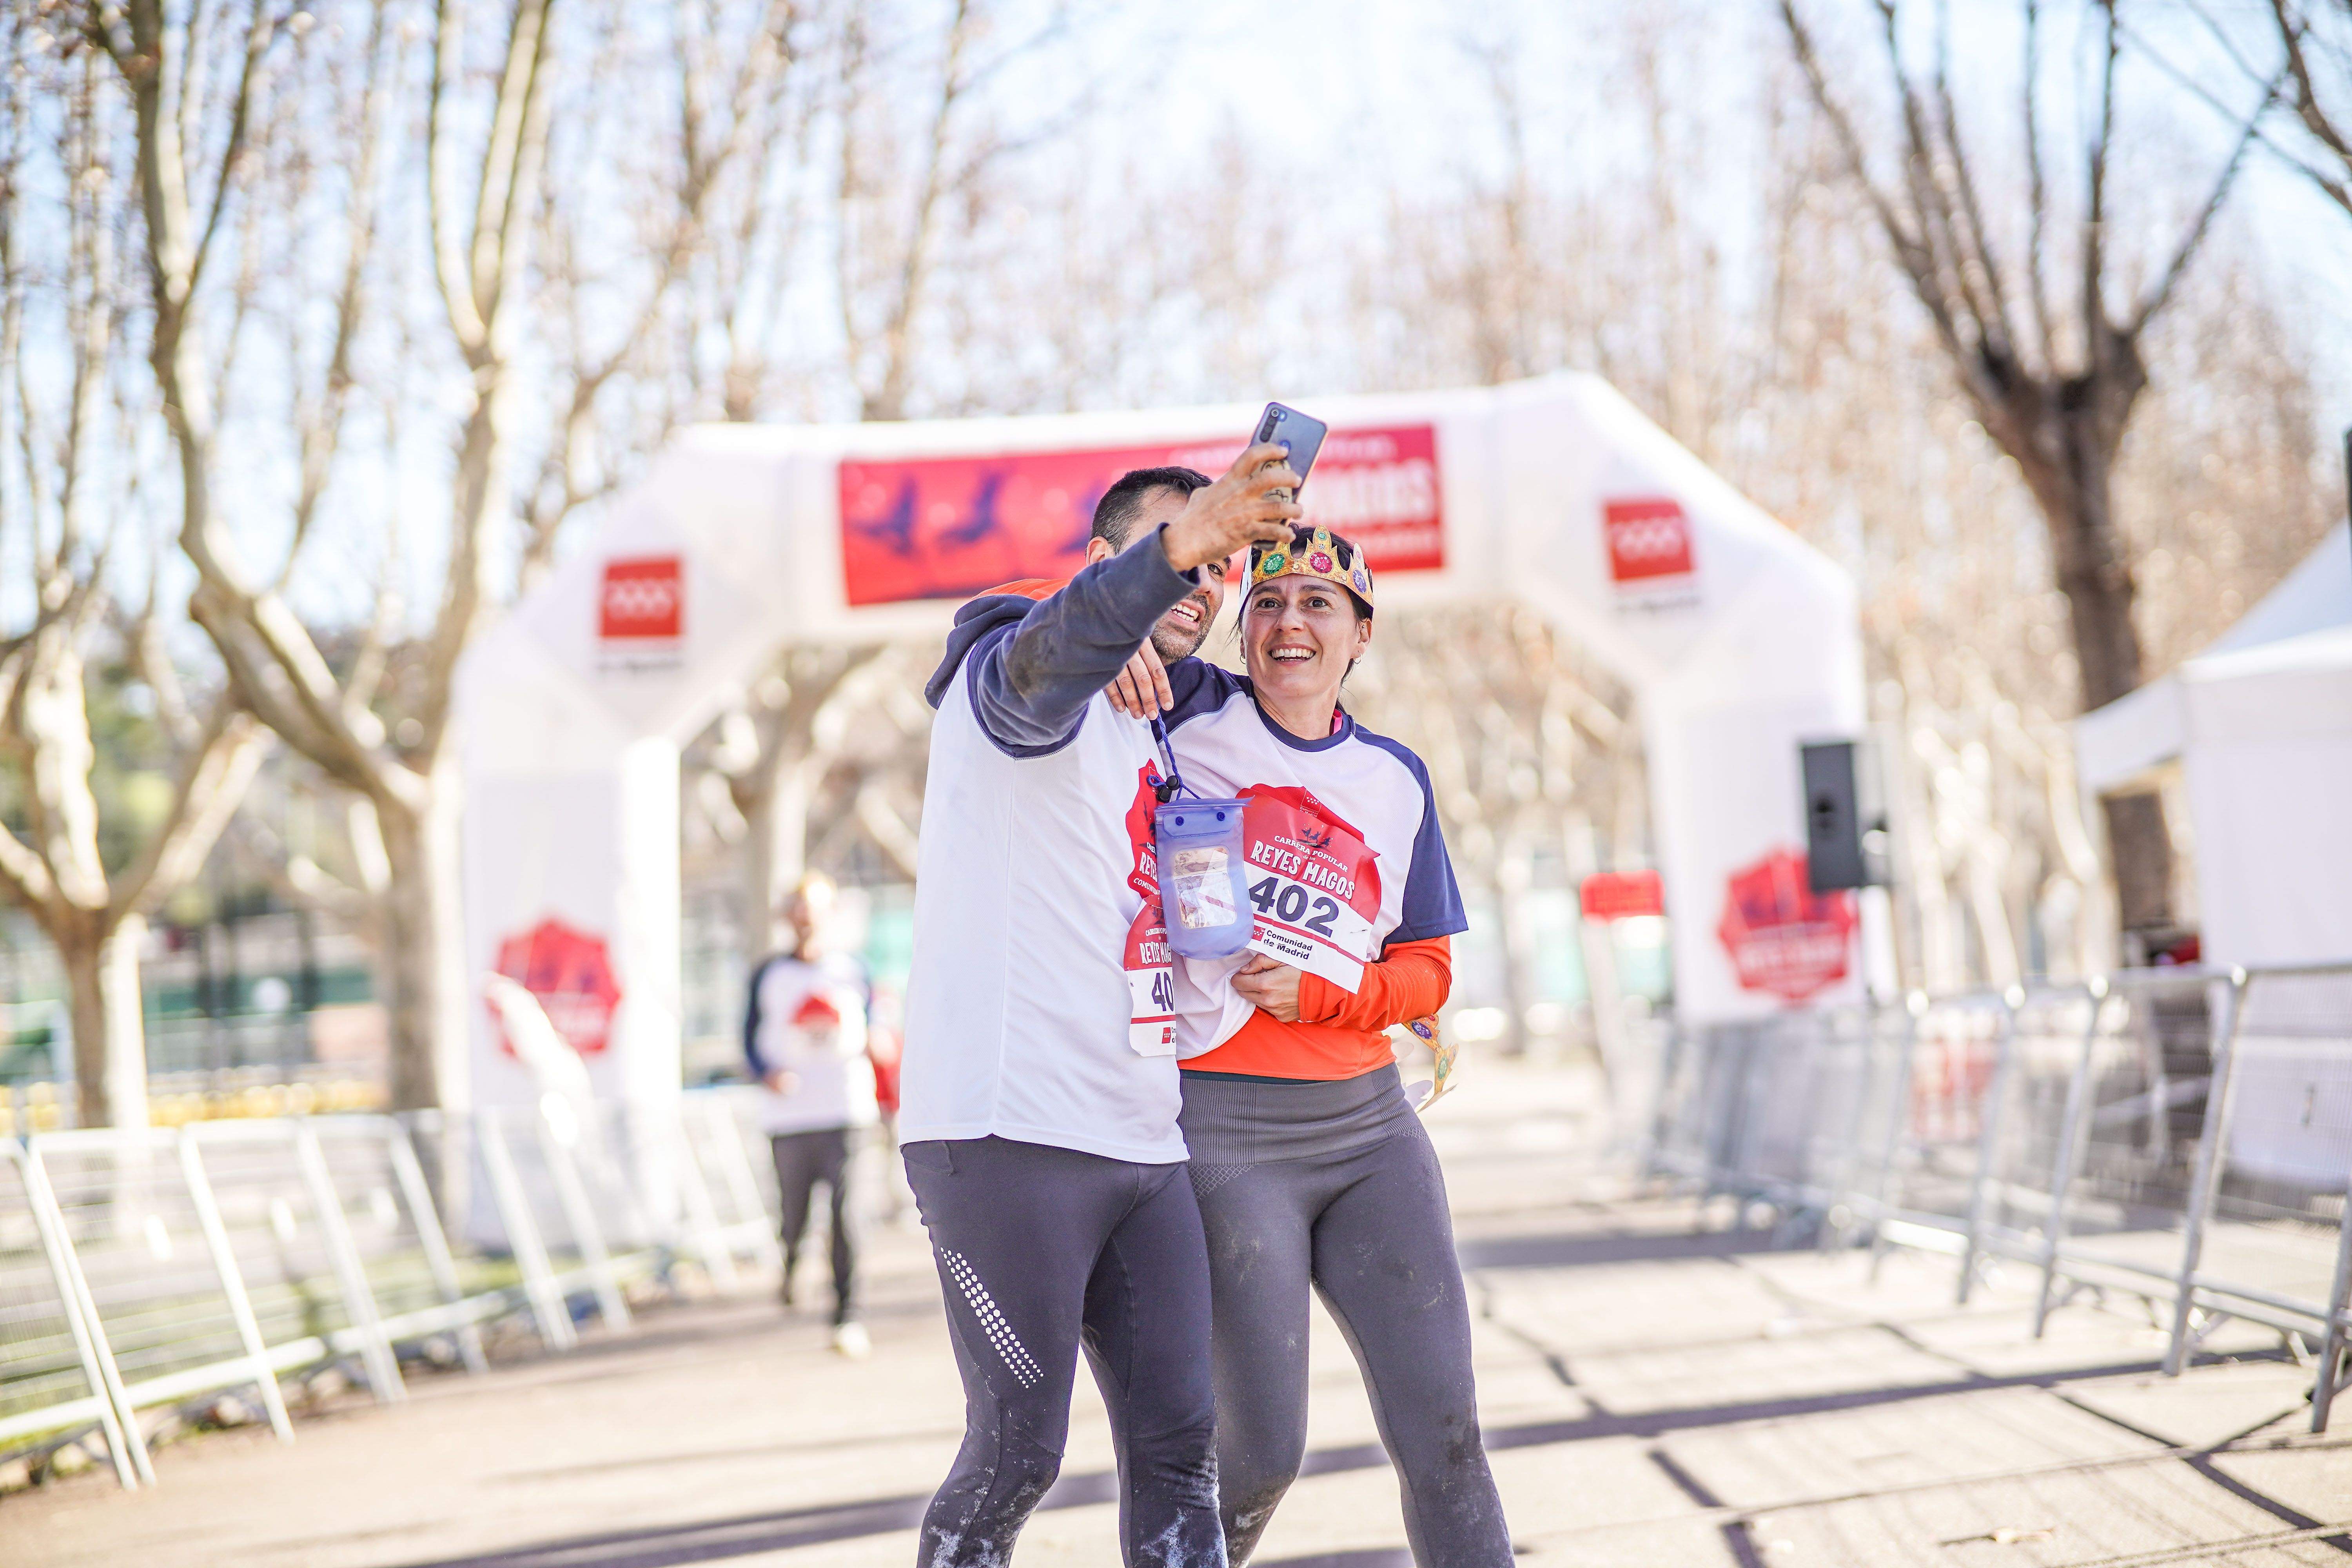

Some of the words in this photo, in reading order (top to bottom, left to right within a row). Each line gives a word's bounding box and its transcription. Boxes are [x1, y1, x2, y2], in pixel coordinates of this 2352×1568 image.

[1250, 840, 1301, 875] REYES
[1302, 862, 1355, 900] MAGOS
[1274, 835, 1310, 855] CARRERA
[1312, 850, 1348, 873] POPULAR
[1249, 877, 1339, 938] 402
[1263, 938, 1274, 947] de
[1277, 943, 1310, 960] Madrid
[1267, 930, 1313, 951] Comunidad
[1152, 971, 1174, 1011] 40
